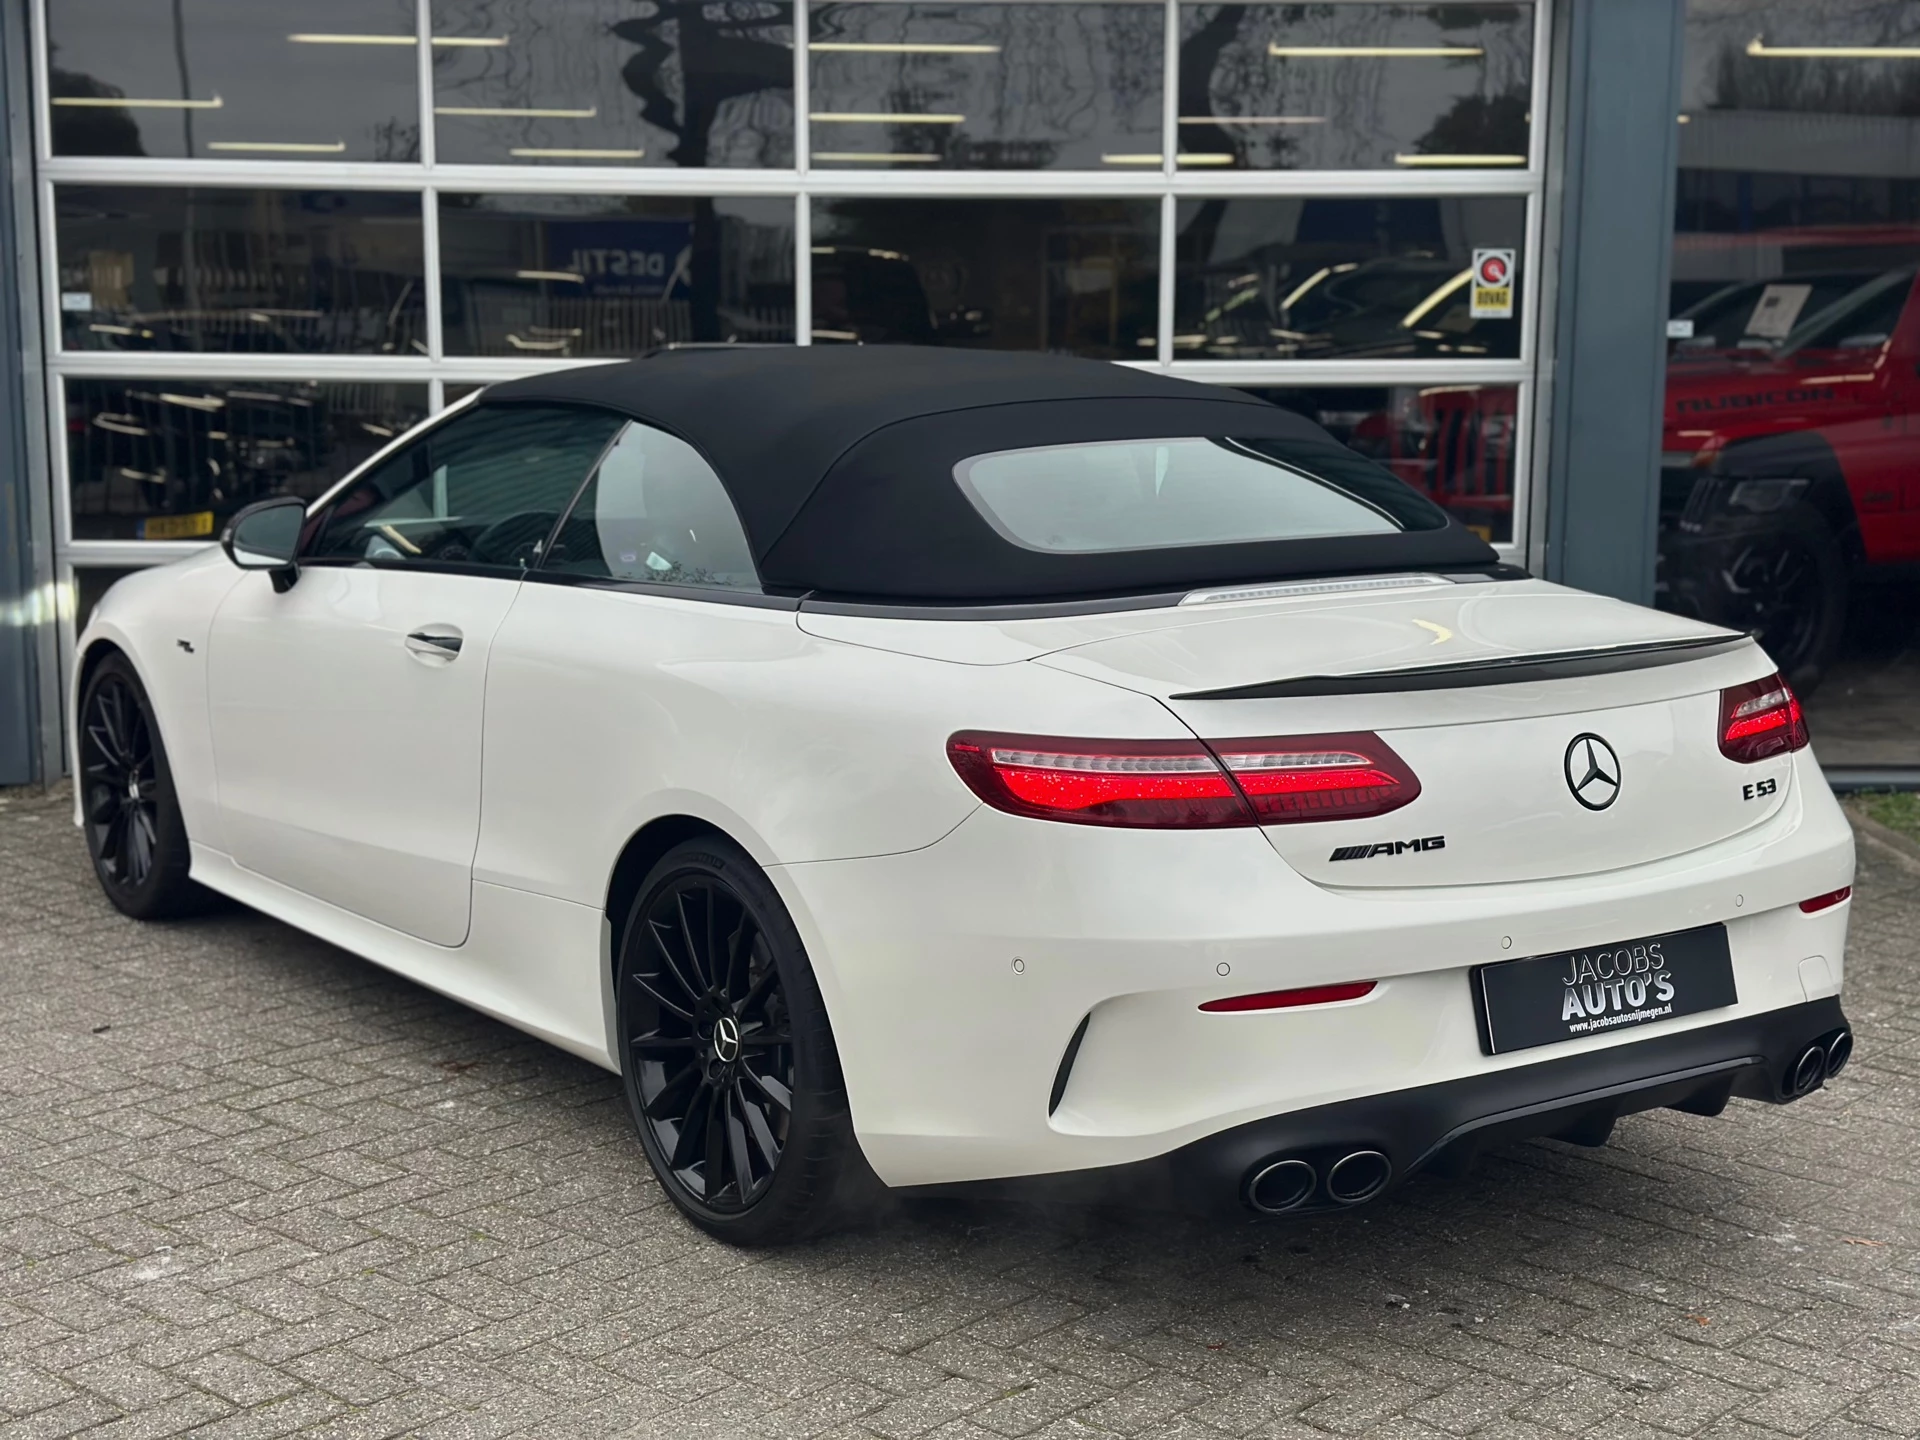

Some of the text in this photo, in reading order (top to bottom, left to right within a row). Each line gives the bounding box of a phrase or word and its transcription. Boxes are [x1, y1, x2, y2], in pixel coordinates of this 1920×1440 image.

[1676, 387, 1835, 414] RUBICON
[1742, 777, 1777, 802] E 53
[1366, 836, 1446, 859] AMG
[1561, 942, 1665, 986] JACOBS
[1561, 970, 1675, 1020] AUTO'S
[1569, 1002, 1673, 1033] www.jacobsautosnijmegen.nl
